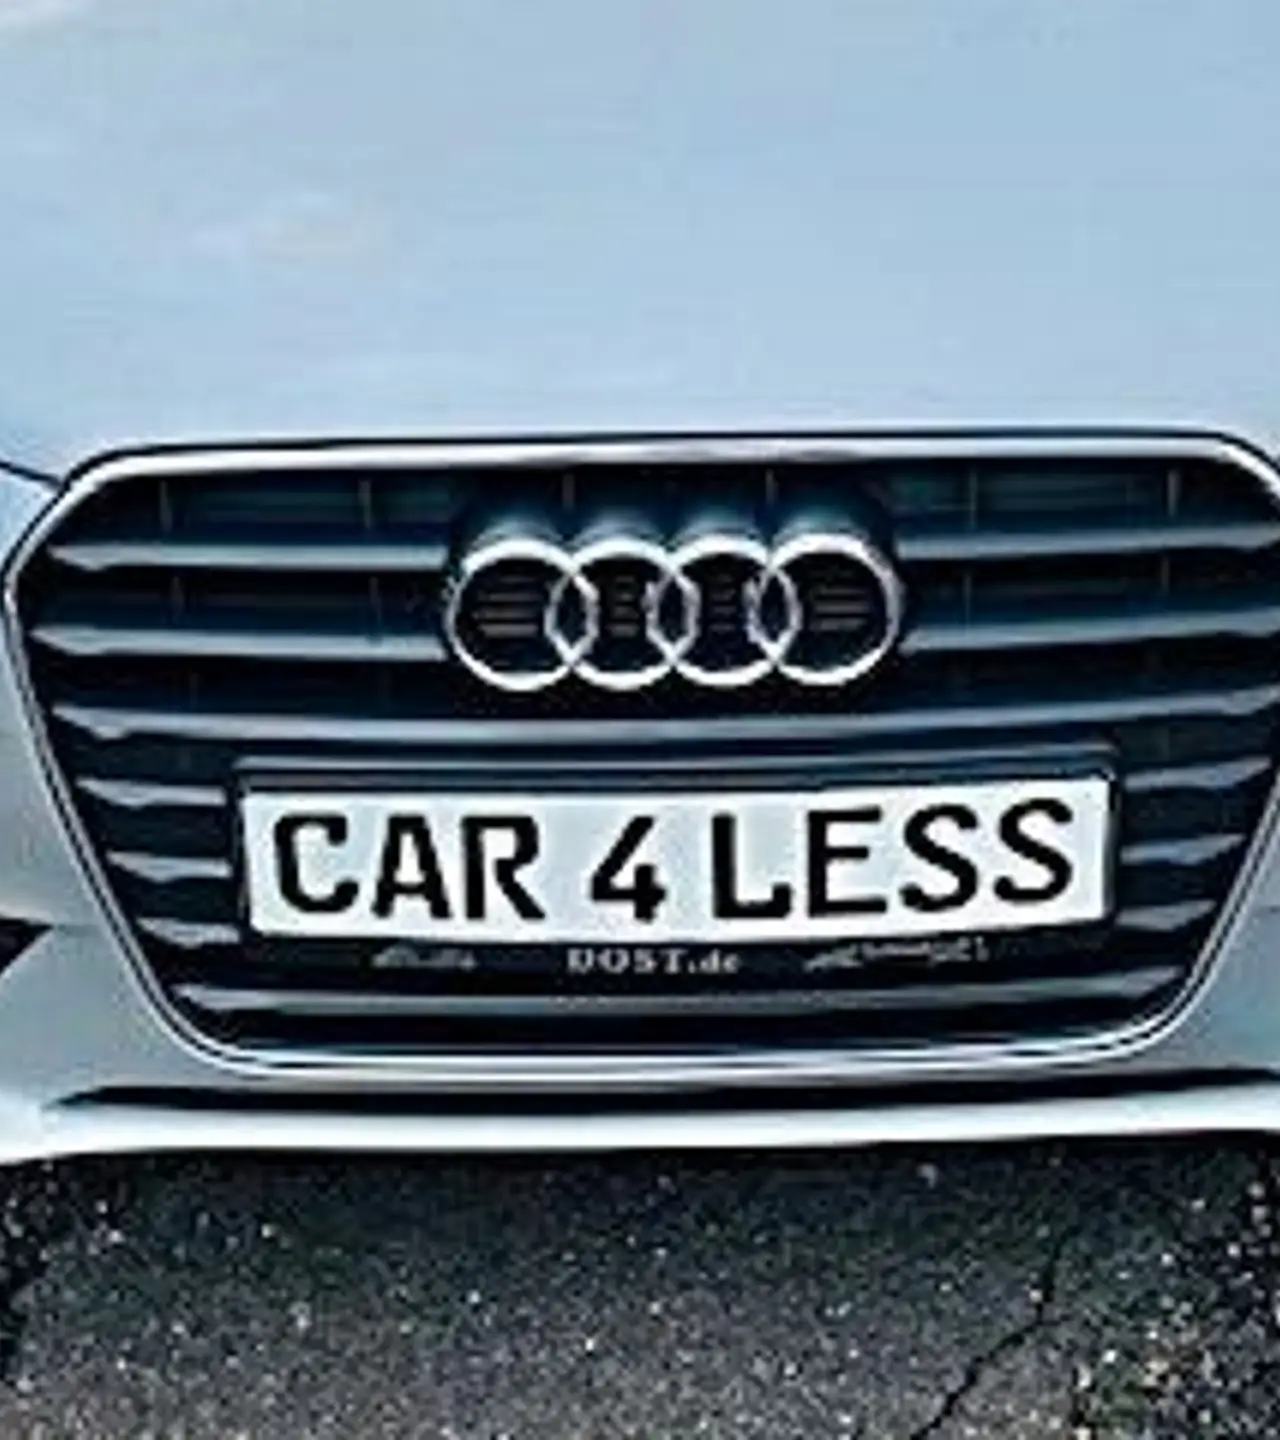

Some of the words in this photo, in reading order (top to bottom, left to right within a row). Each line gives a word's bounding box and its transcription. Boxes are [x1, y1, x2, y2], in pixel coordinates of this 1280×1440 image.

[273, 812, 546, 921] CAR
[589, 814, 667, 922] 4
[710, 797, 1075, 921] LESS
